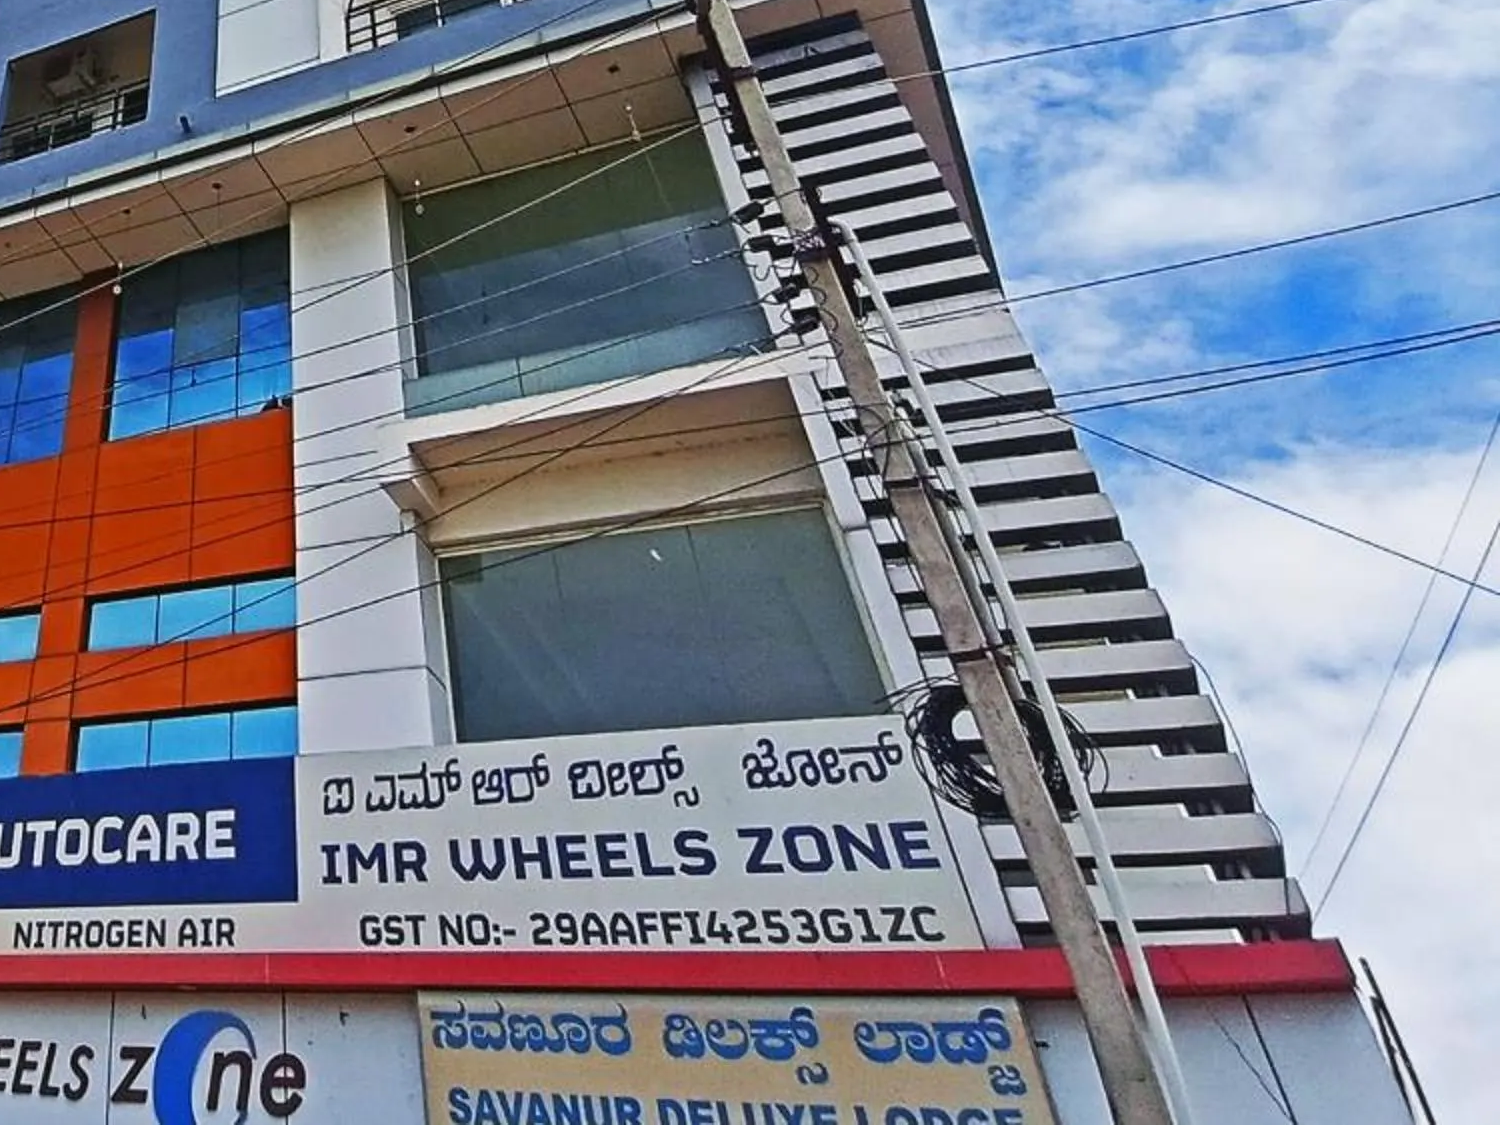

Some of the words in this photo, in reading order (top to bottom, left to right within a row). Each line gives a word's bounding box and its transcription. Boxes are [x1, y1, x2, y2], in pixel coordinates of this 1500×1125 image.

[323, 777, 354, 815] ಐ
[321, 841, 427, 884] IMR
[449, 827, 717, 882] WHEELS
[737, 820, 941, 873] ZONE
[13, 918, 167, 948] NITROGEN
[178, 917, 236, 947] AIR
[359, 914, 426, 946] GST
[448, 1086, 642, 1125] SAVANUR
